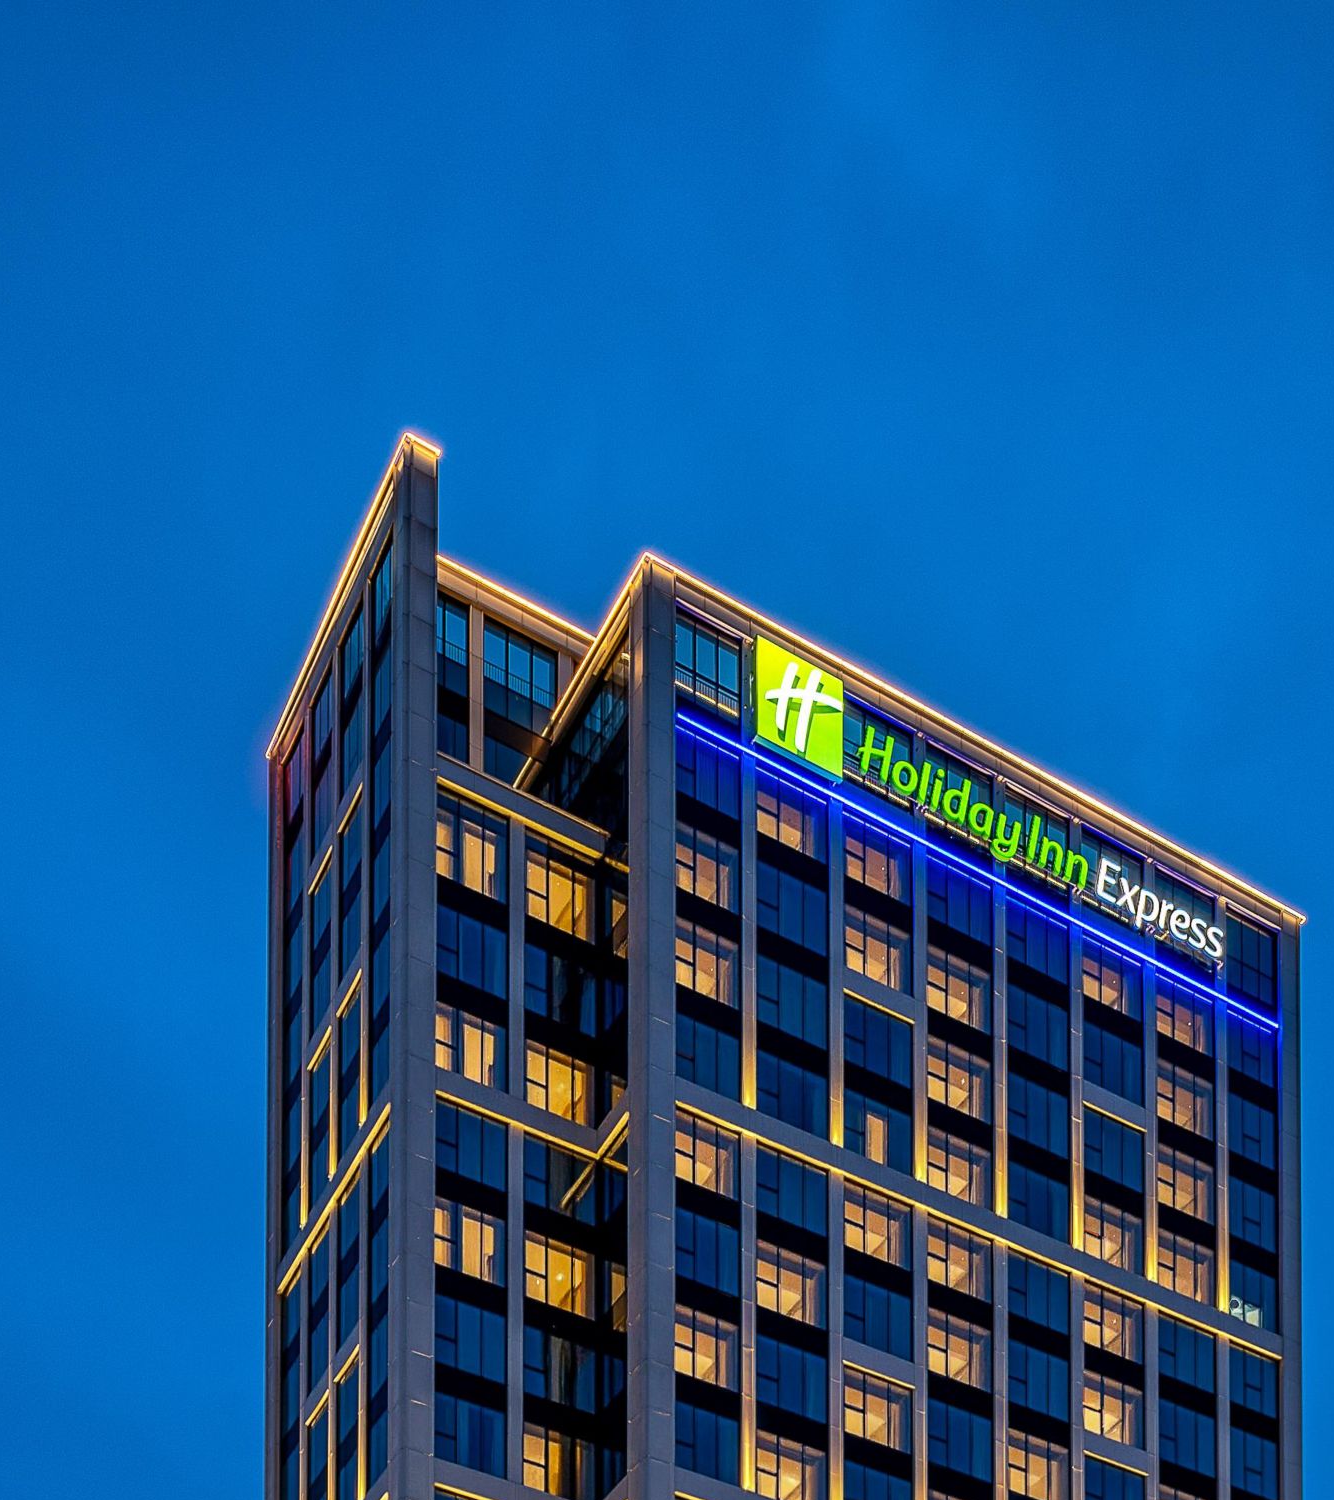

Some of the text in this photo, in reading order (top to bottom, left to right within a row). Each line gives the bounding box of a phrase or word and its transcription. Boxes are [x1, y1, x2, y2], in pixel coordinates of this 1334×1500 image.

[857, 724, 1022, 862] Holiday
[1025, 814, 1089, 890] Inn
[1096, 856, 1225, 958] Express
